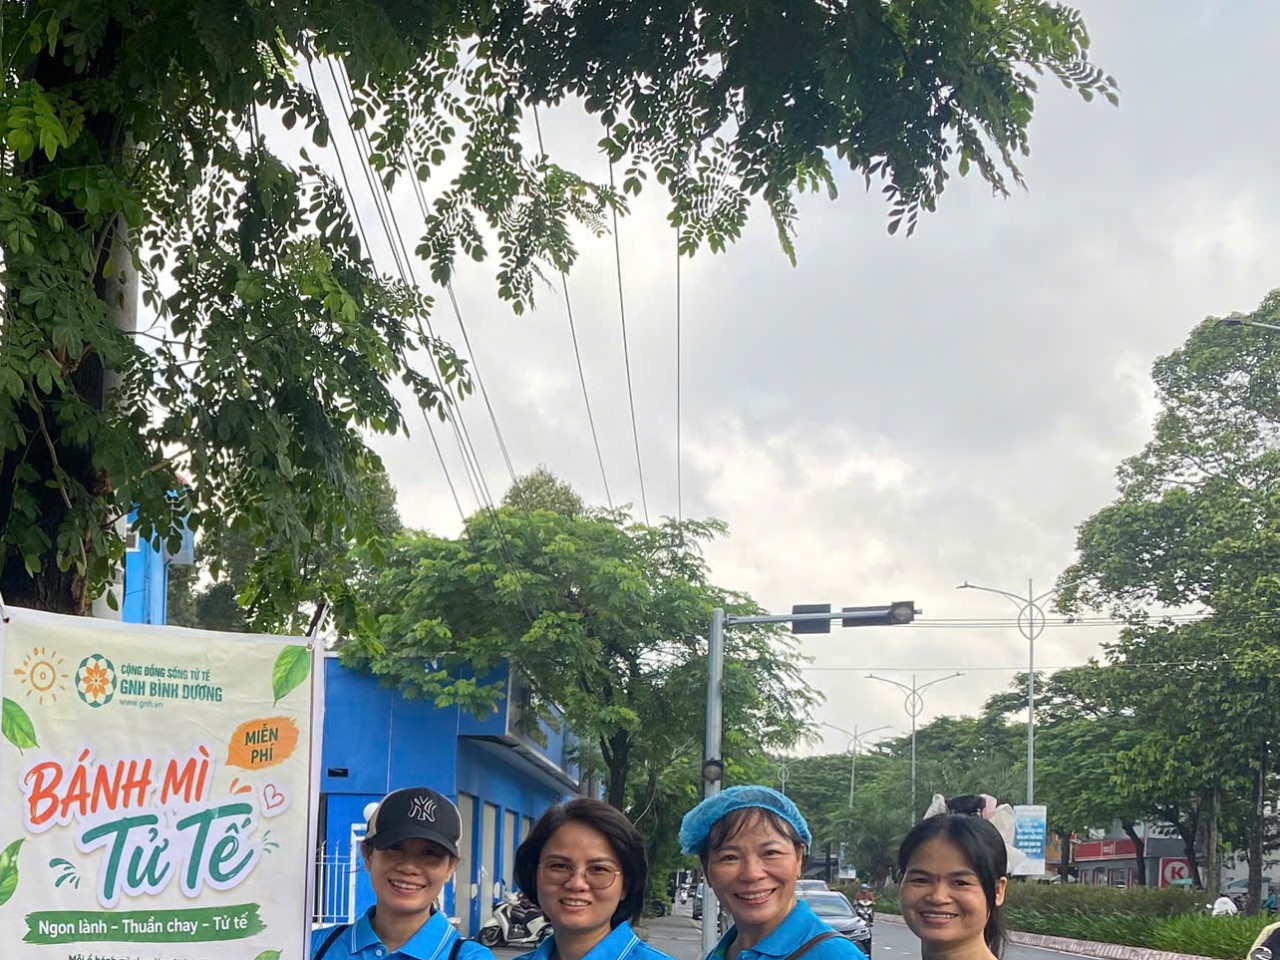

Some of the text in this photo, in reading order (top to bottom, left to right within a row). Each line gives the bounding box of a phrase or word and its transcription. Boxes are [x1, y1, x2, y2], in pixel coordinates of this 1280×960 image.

[120, 678, 223, 702] GNH BÌNH DƯƠNG
[245, 723, 278, 746] MIỄN
[251, 743, 274, 764] PHÍ
[23, 745, 210, 826] BÁNH MÌ
[82, 802, 254, 901] Tử Tế
[1172, 867, 1184, 879] K
[39, 920, 75, 938] Ngon
[79, 919, 107, 934] lành
[122, 915, 163, 934] Thuần
[167, 919, 198, 935] chay
[213, 915, 230, 930] Tử
[234, 912, 249, 929] tế
